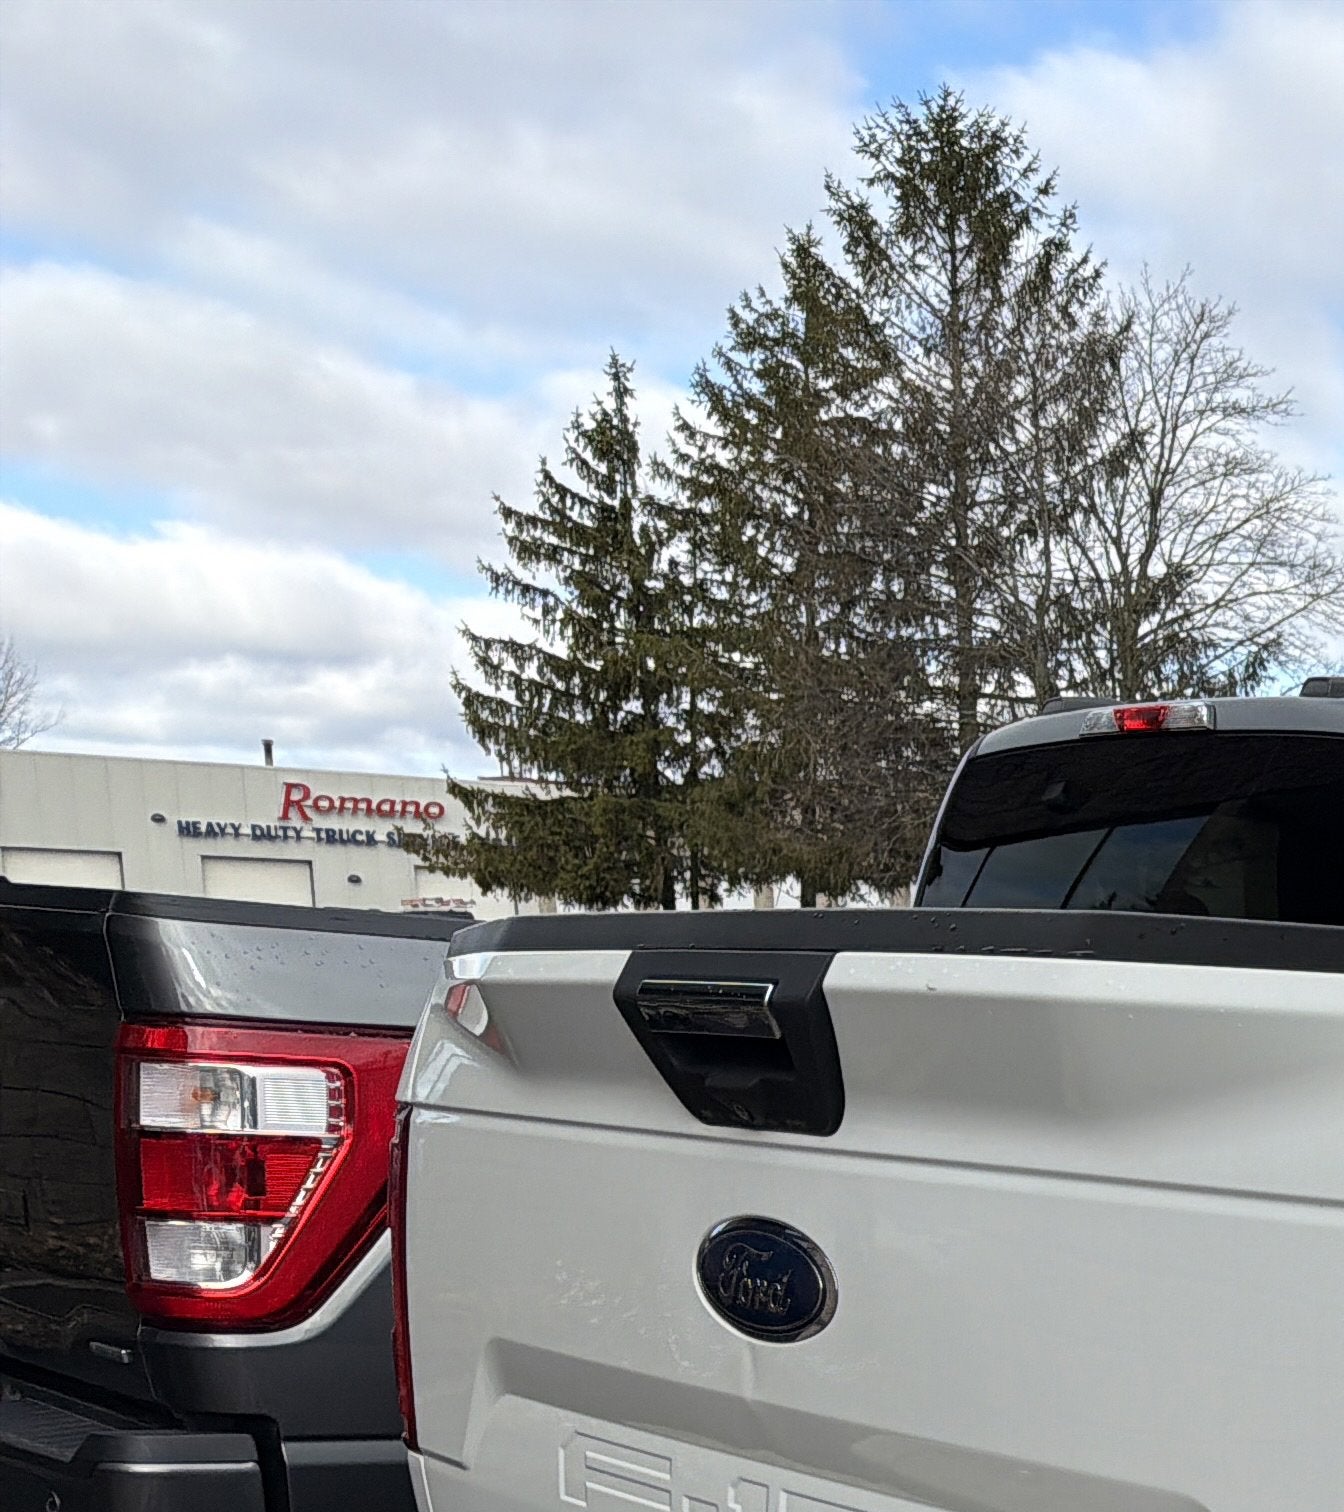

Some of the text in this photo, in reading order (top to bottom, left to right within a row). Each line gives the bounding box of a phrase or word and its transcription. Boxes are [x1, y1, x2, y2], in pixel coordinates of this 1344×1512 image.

[279, 781, 445, 822] Romano
[177, 820, 241, 838] HEAVY
[251, 824, 303, 842] DUTY
[312, 827, 378, 846] TRUCK
[718, 1243, 791, 1313] Ford
